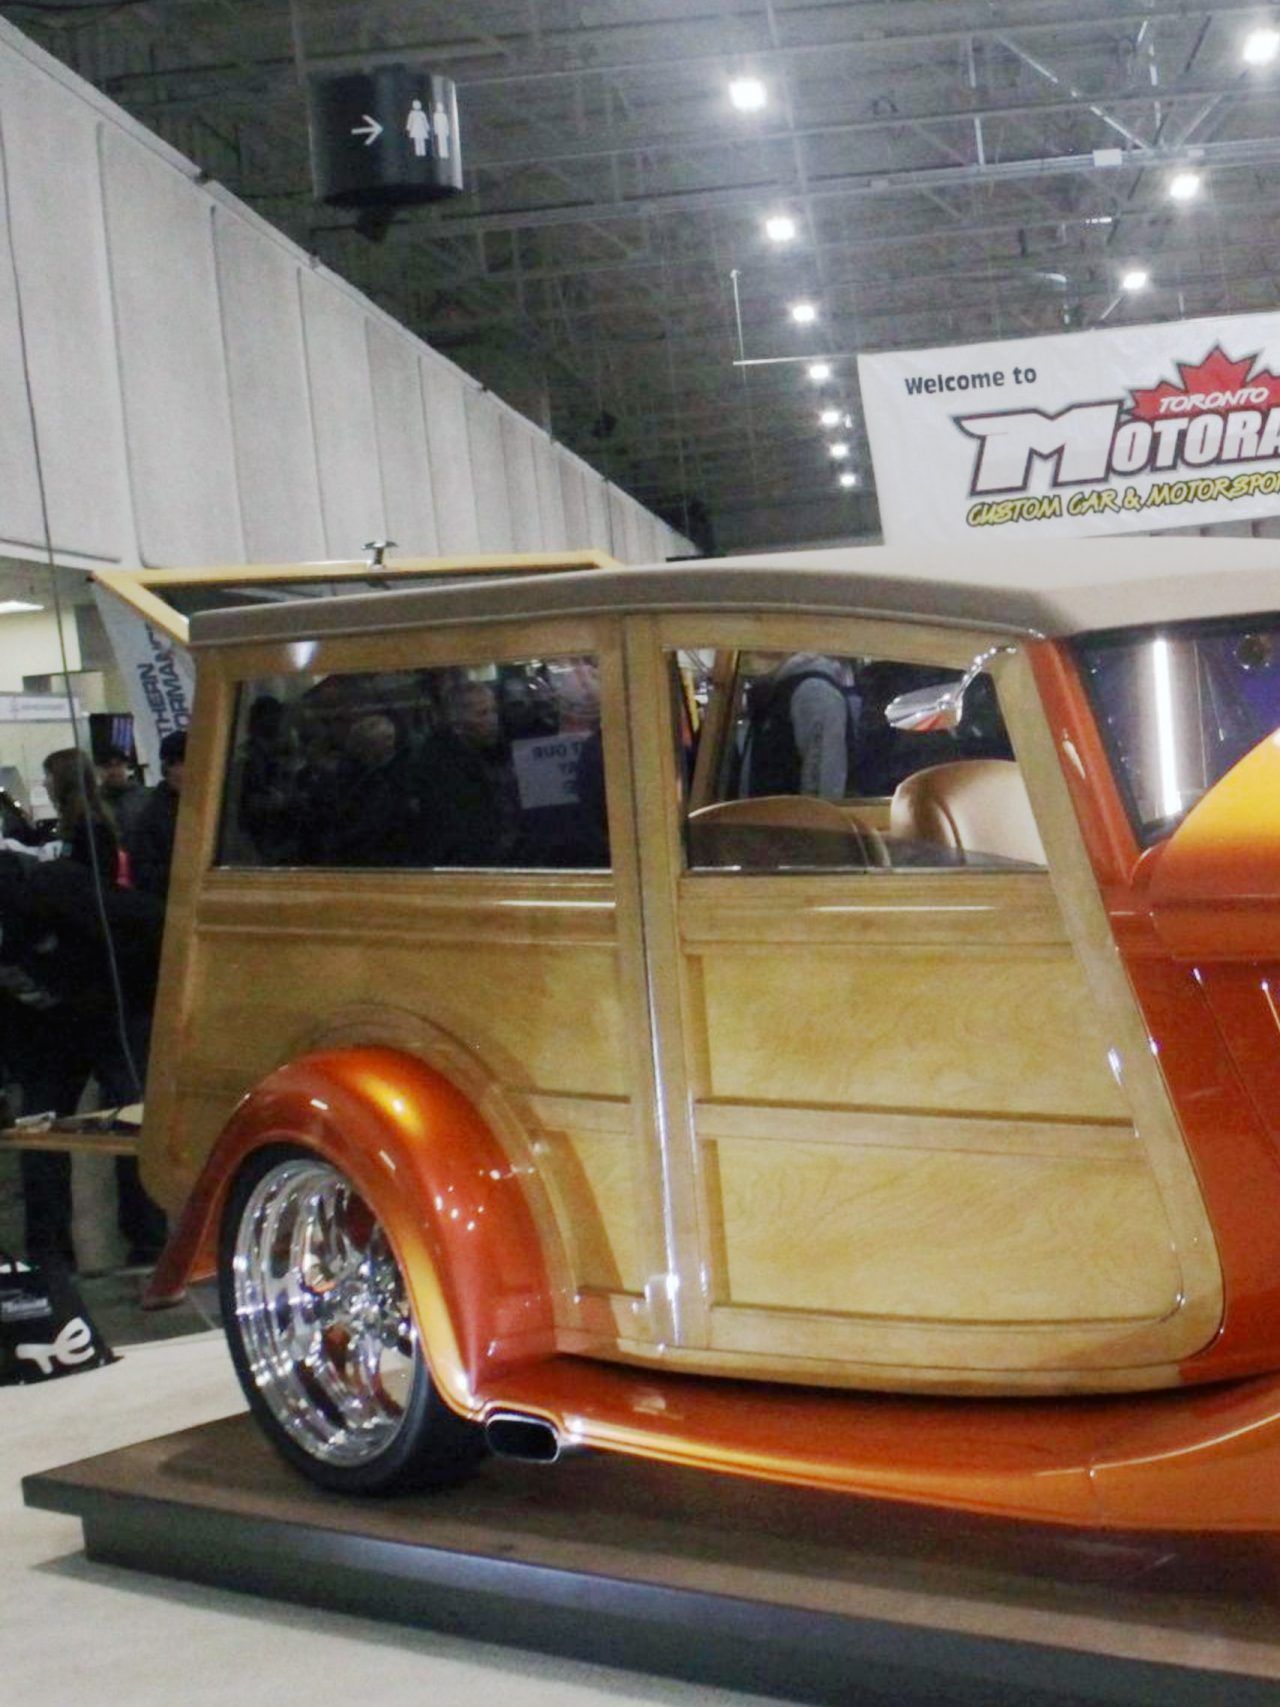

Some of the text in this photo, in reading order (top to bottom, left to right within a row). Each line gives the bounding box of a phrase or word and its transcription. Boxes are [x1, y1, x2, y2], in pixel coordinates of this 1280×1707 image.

[905, 366, 1037, 395] Welcome to
[1158, 386, 1269, 414] TORONTO
[966, 495, 1062, 527] CUSTOM
[1067, 486, 1121, 516] CAR
[1122, 486, 1142, 511] &
